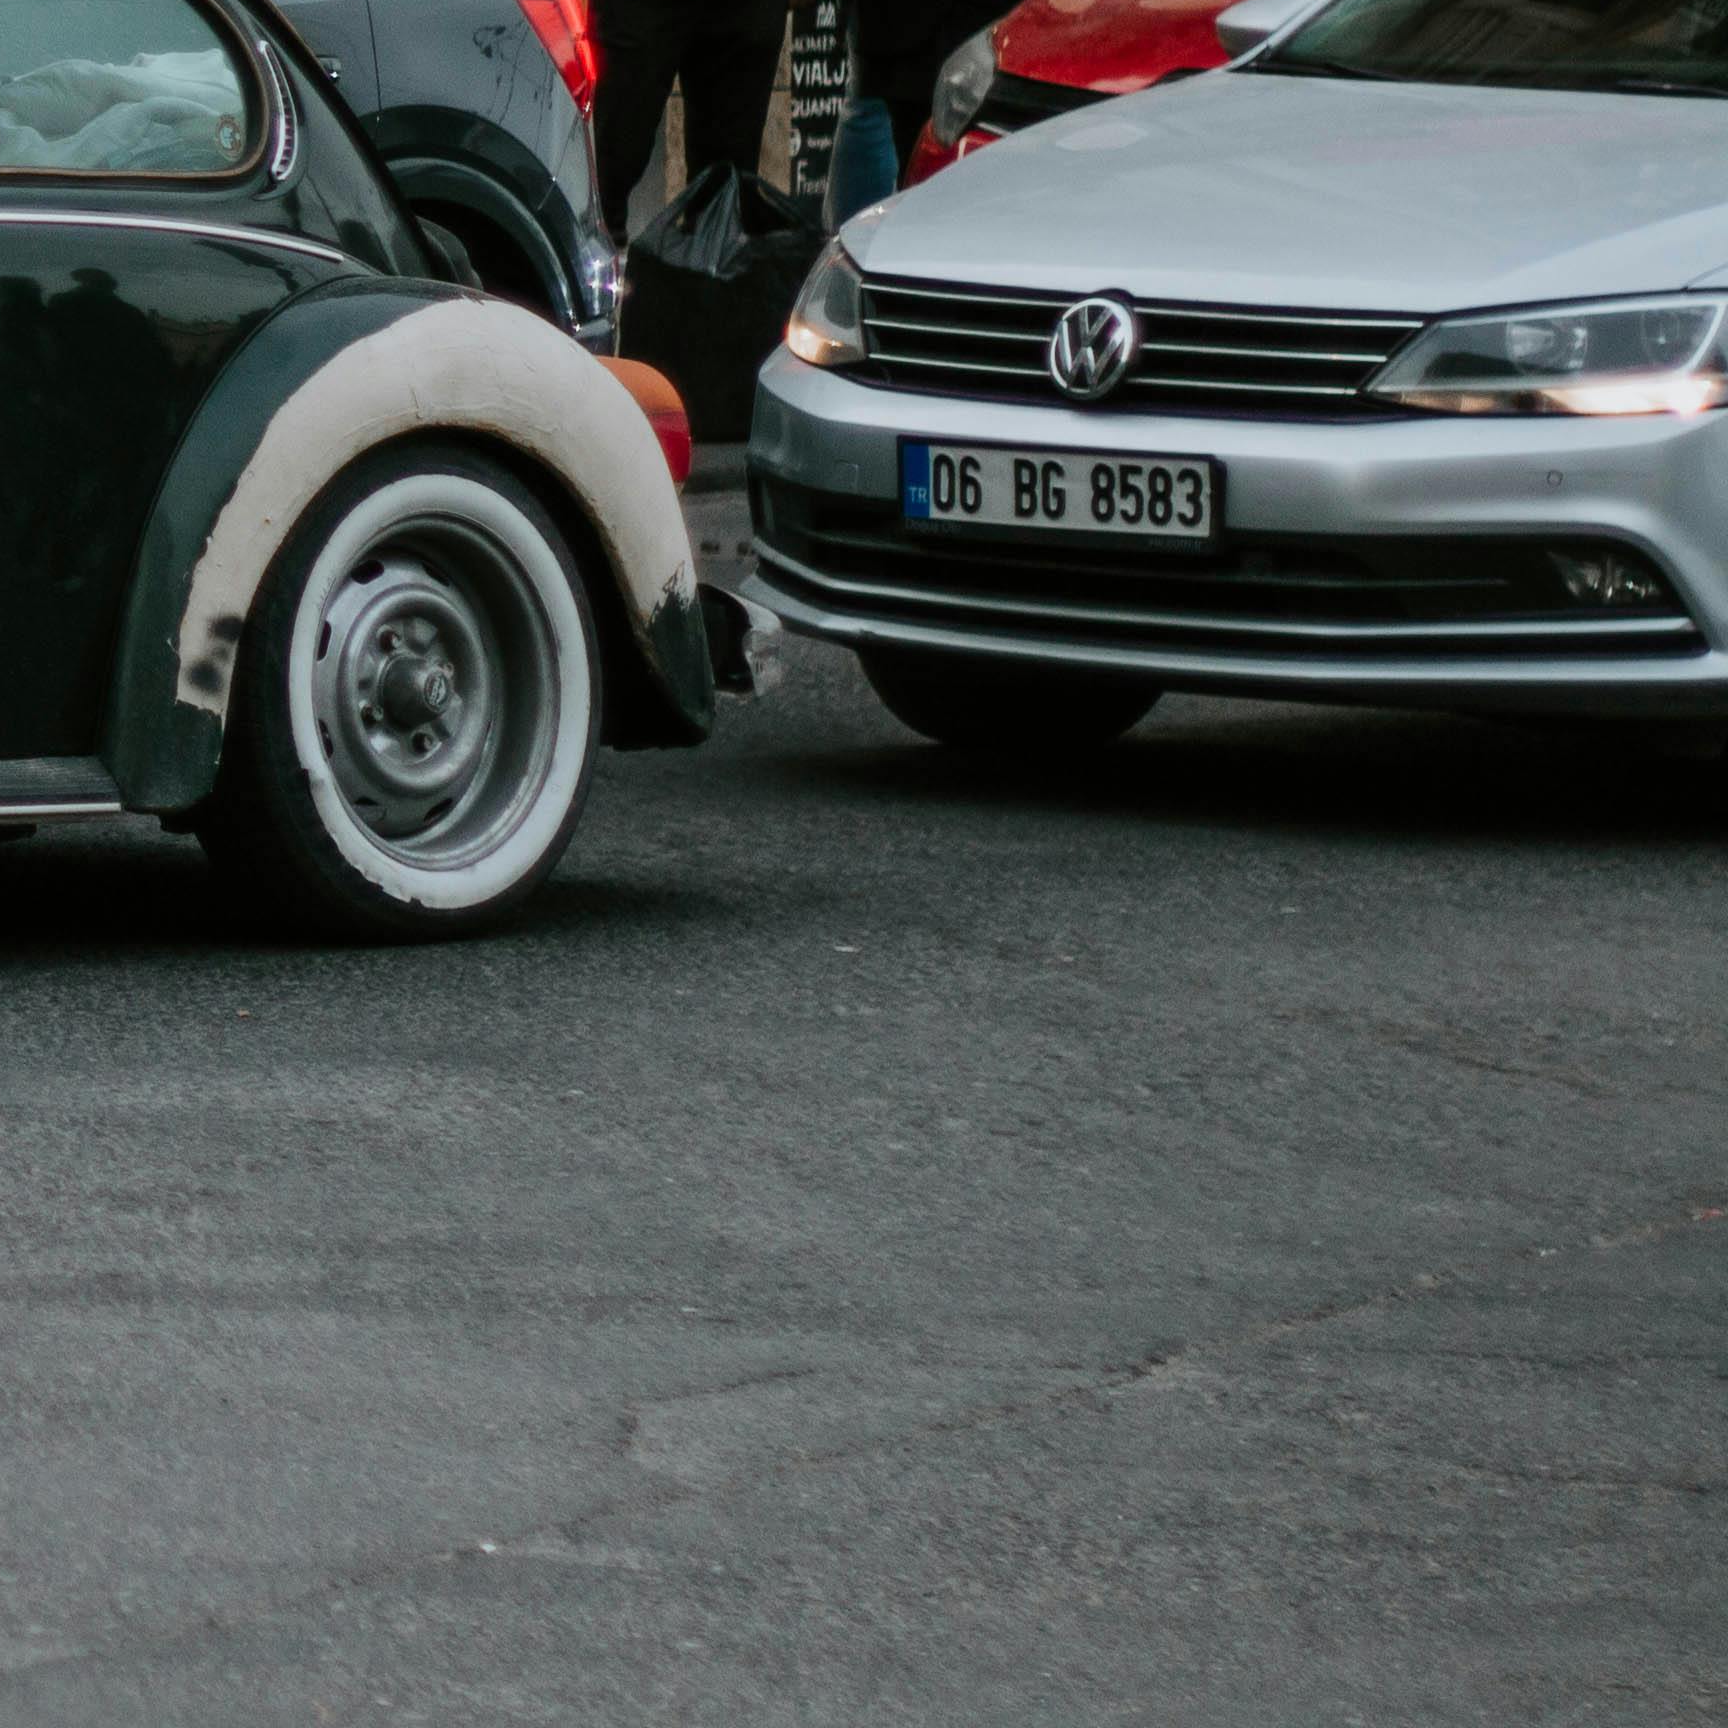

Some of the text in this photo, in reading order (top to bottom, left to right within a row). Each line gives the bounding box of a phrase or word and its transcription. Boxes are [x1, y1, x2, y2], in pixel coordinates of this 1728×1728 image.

[932, 454, 982, 515] 06
[1013, 458, 1067, 520] BG
[1091, 462, 1206, 528] 8583
